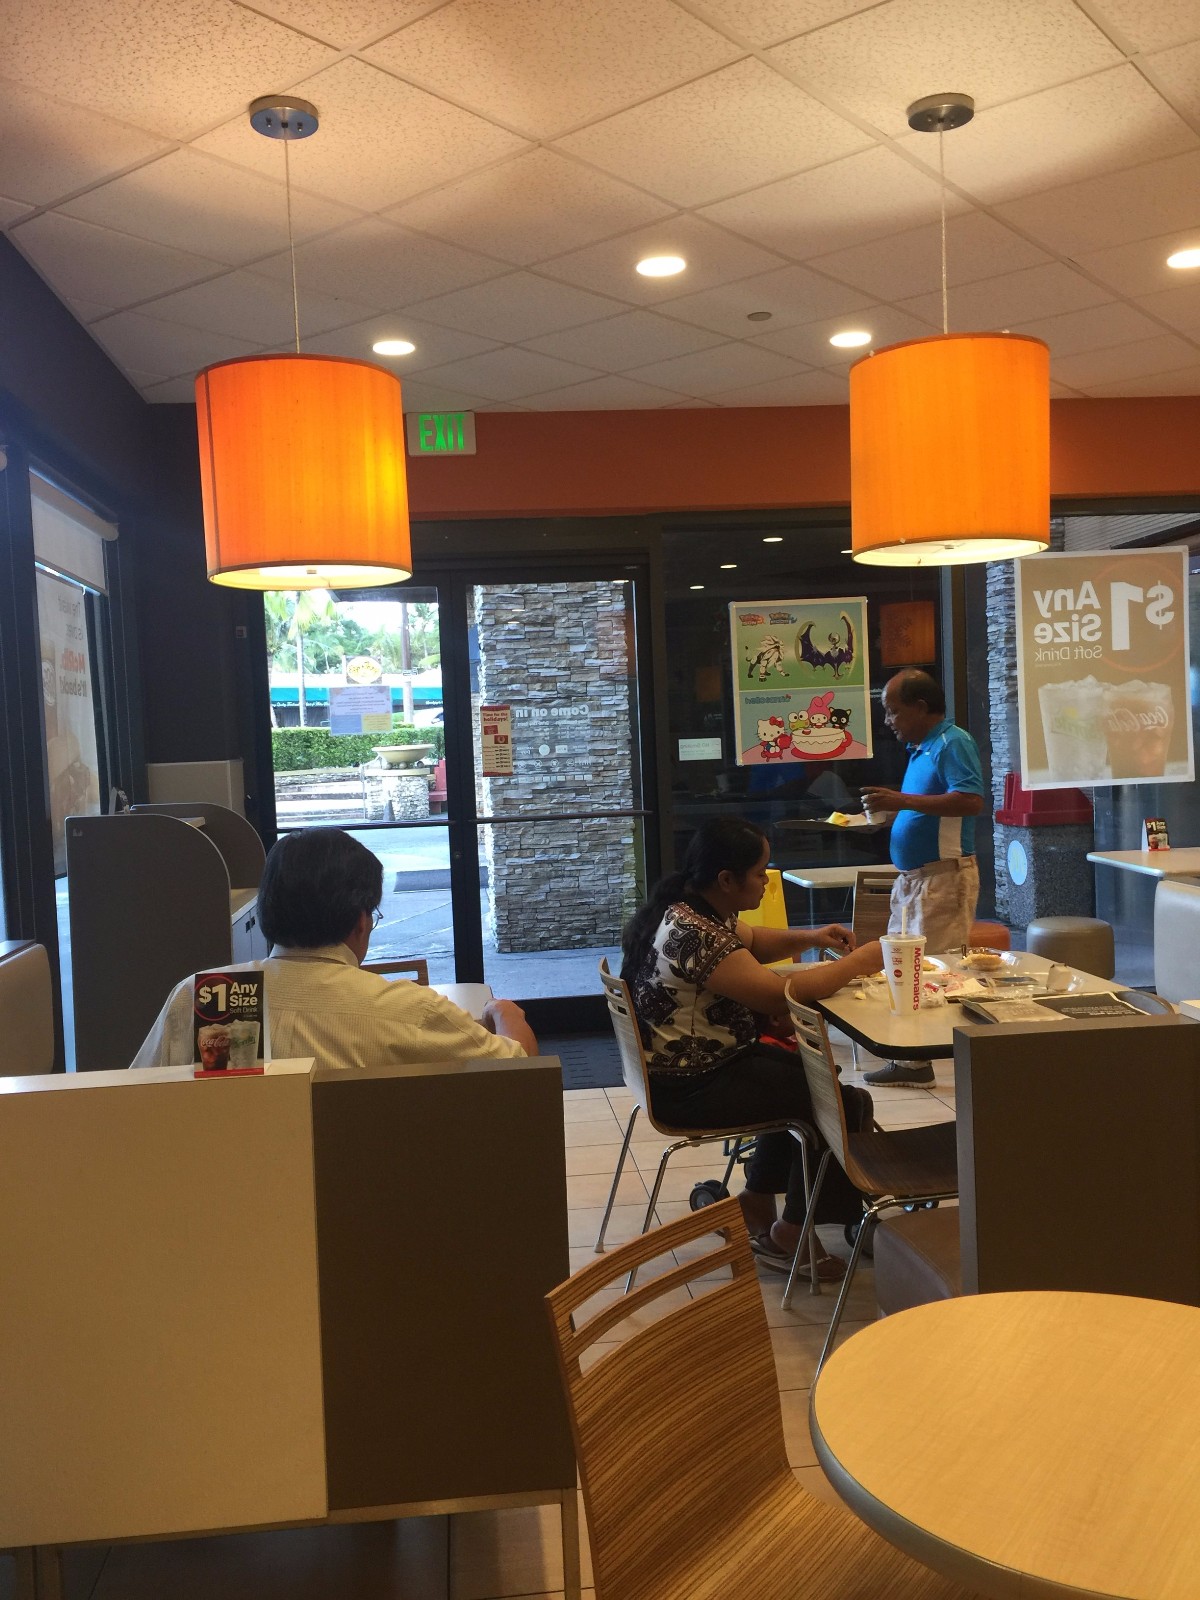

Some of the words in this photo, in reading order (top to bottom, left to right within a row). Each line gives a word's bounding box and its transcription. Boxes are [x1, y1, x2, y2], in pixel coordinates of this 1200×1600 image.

[419, 414, 464, 452] EXIT
[912, 947, 922, 1011] McDonald's
[198, 983, 227, 1012] $1
[230, 981, 258, 995] Any
[229, 995, 258, 1007] Size
[242, 1006, 258, 1014] Drink
